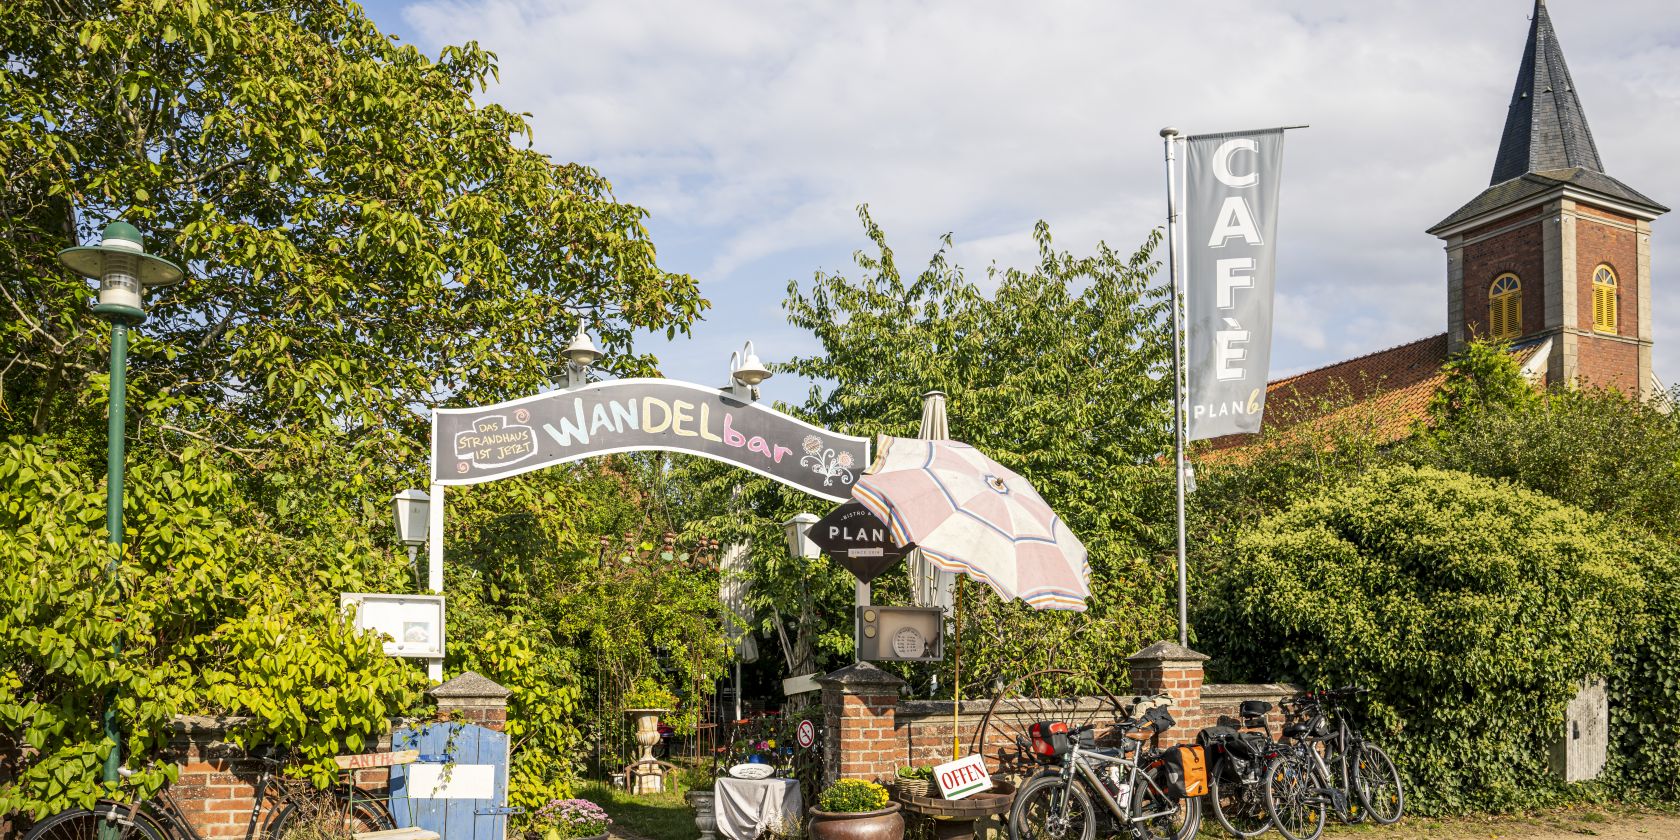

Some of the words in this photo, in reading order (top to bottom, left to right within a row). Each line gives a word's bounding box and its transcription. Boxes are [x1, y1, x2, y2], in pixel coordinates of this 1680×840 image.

[1193, 400, 1244, 419] PLAN
[478, 422, 499, 433] DAS
[543, 396, 793, 465] WANDELbar
[458, 430, 529, 449] STRANDHAUS
[475, 448, 492, 460] IST
[497, 441, 531, 460] JETZT
[828, 526, 885, 542] PLAN
[349, 753, 396, 769] ANTIK
[941, 761, 986, 790] OFFEN
